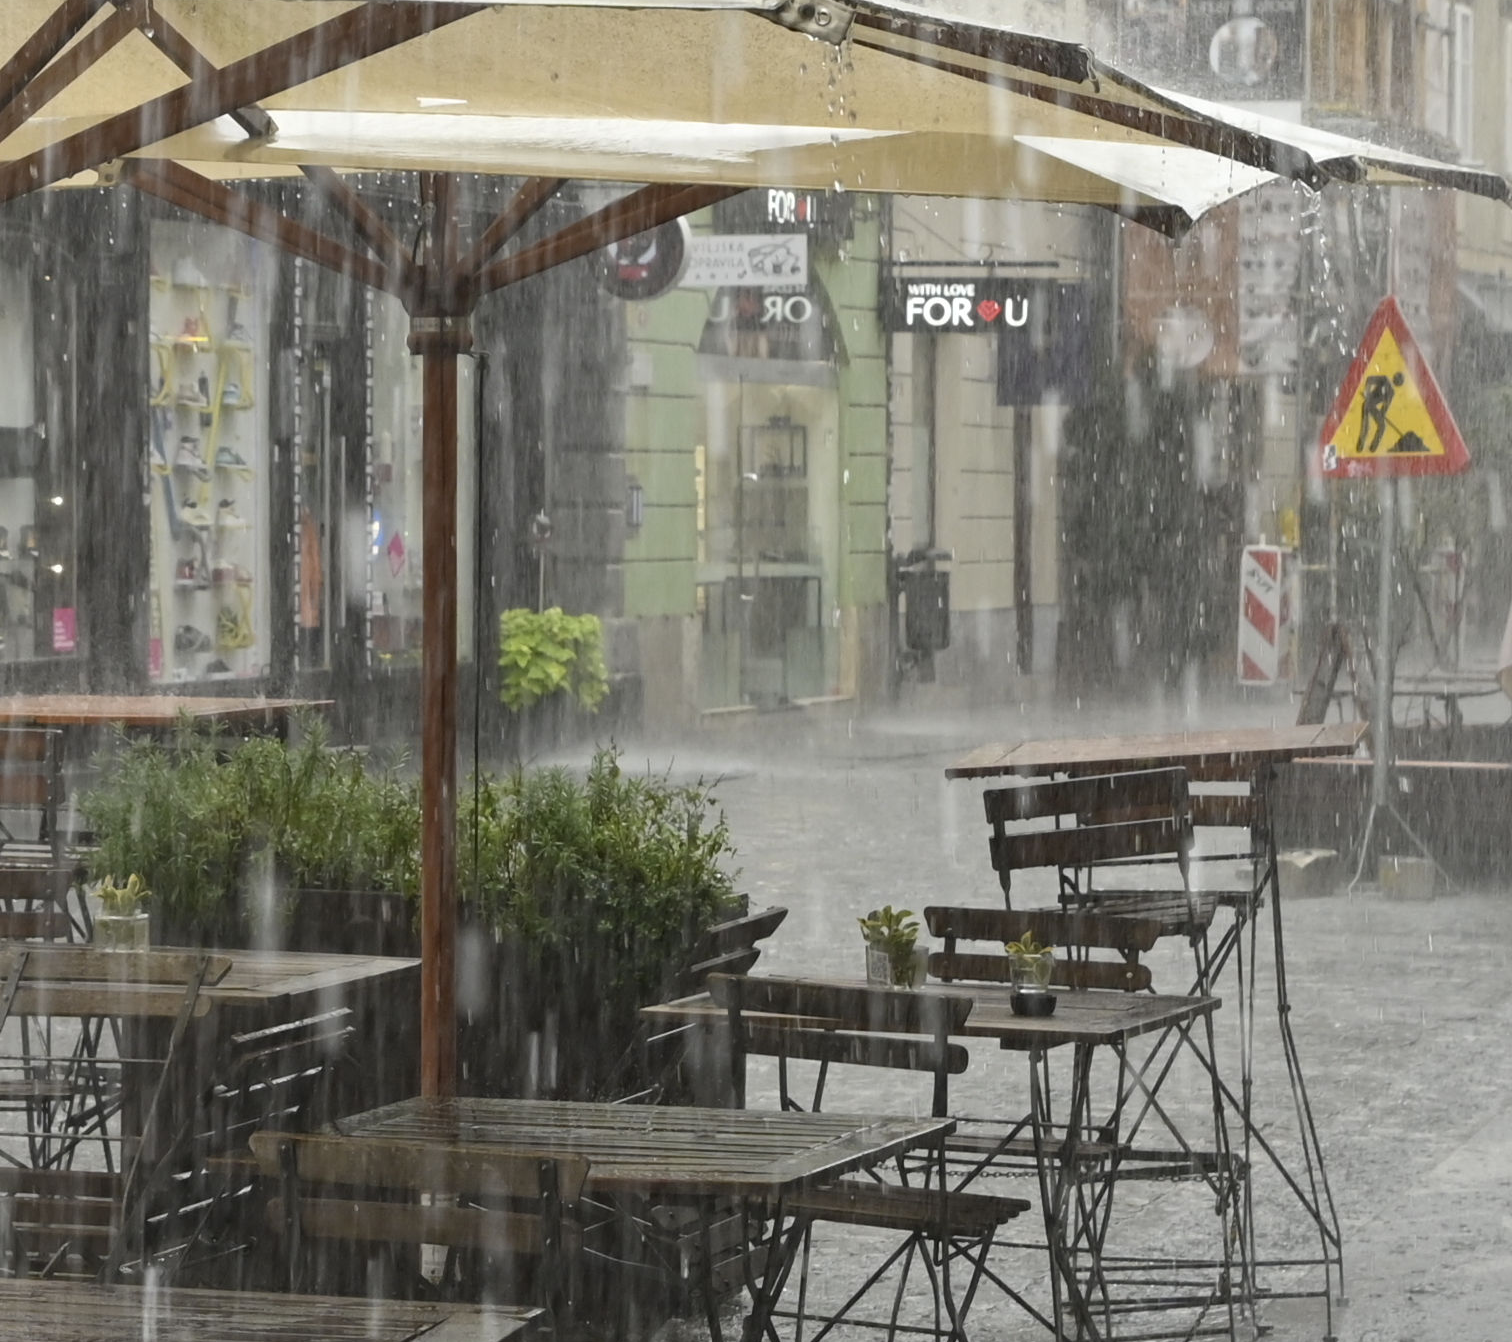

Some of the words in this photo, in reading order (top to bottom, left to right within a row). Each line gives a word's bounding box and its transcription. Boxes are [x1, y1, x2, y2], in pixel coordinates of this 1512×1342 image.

[908, 283, 942, 296] WITH
[943, 284, 975, 296] LOVE
[906, 297, 974, 326] FOR
[1005, 297, 1028, 327] U
